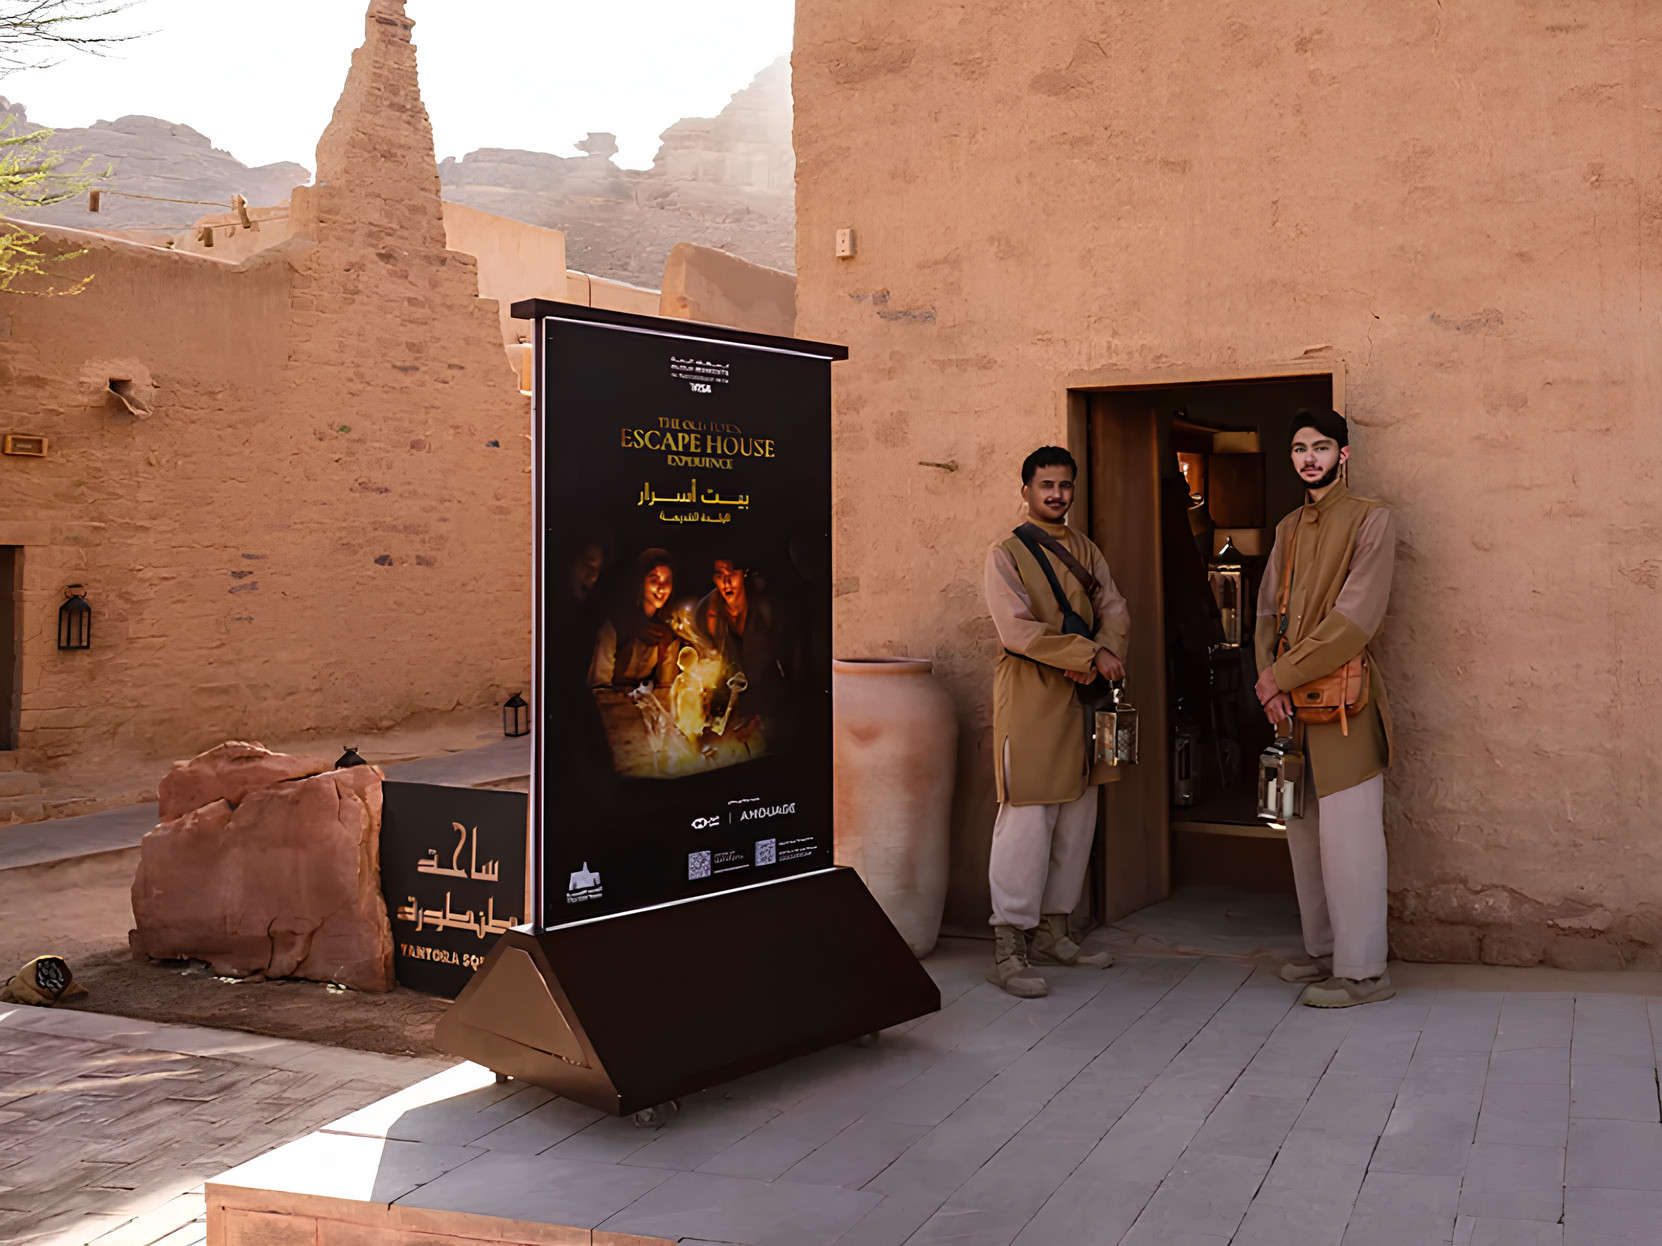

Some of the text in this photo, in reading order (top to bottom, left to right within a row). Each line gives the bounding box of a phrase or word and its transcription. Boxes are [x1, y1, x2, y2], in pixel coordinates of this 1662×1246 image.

[621, 428, 775, 458] ESCAPE HOUSE
[701, 488, 749, 509] بيت
